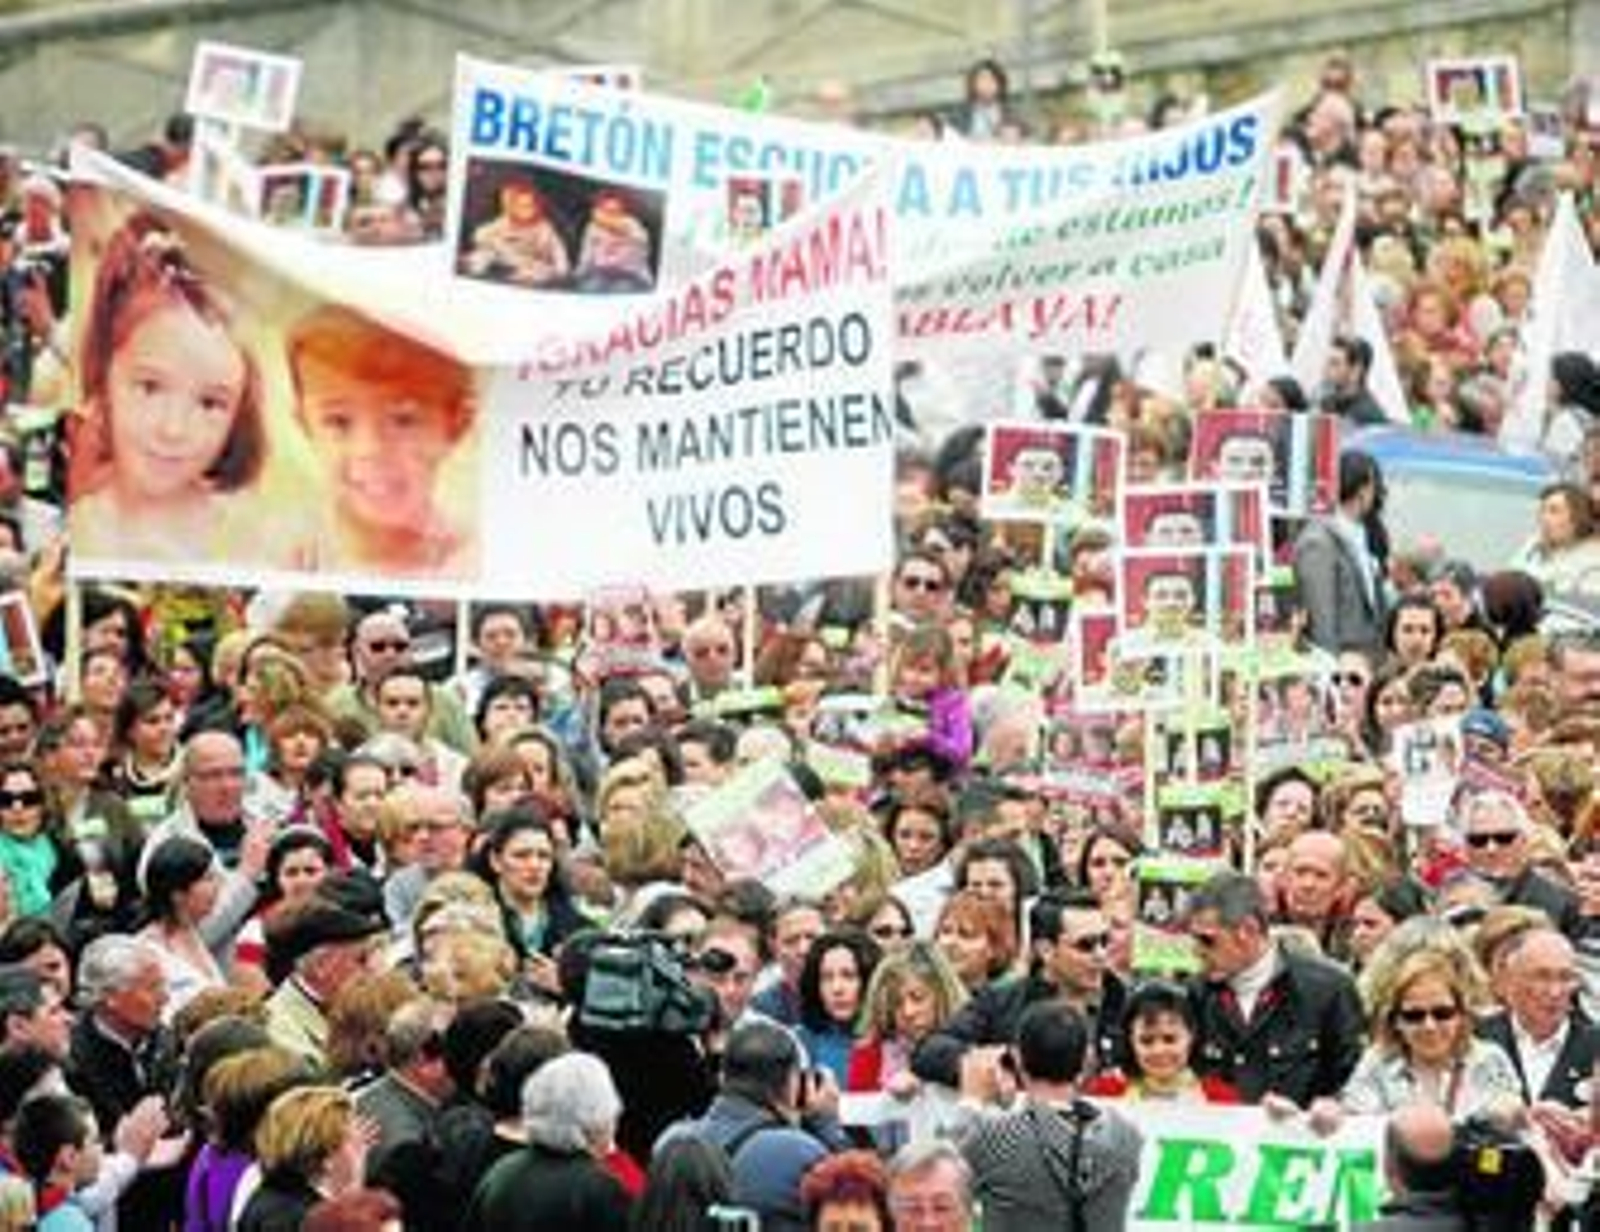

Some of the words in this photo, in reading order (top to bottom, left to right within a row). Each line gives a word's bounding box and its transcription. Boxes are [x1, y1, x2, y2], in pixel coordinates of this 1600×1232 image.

[470, 88, 674, 178] BRETÓN
[622, 311, 873, 397] RECUERDO
[519, 421, 621, 477] NOS
[635, 391, 893, 473] MANTIENEN
[647, 480, 787, 546] VIVOS
